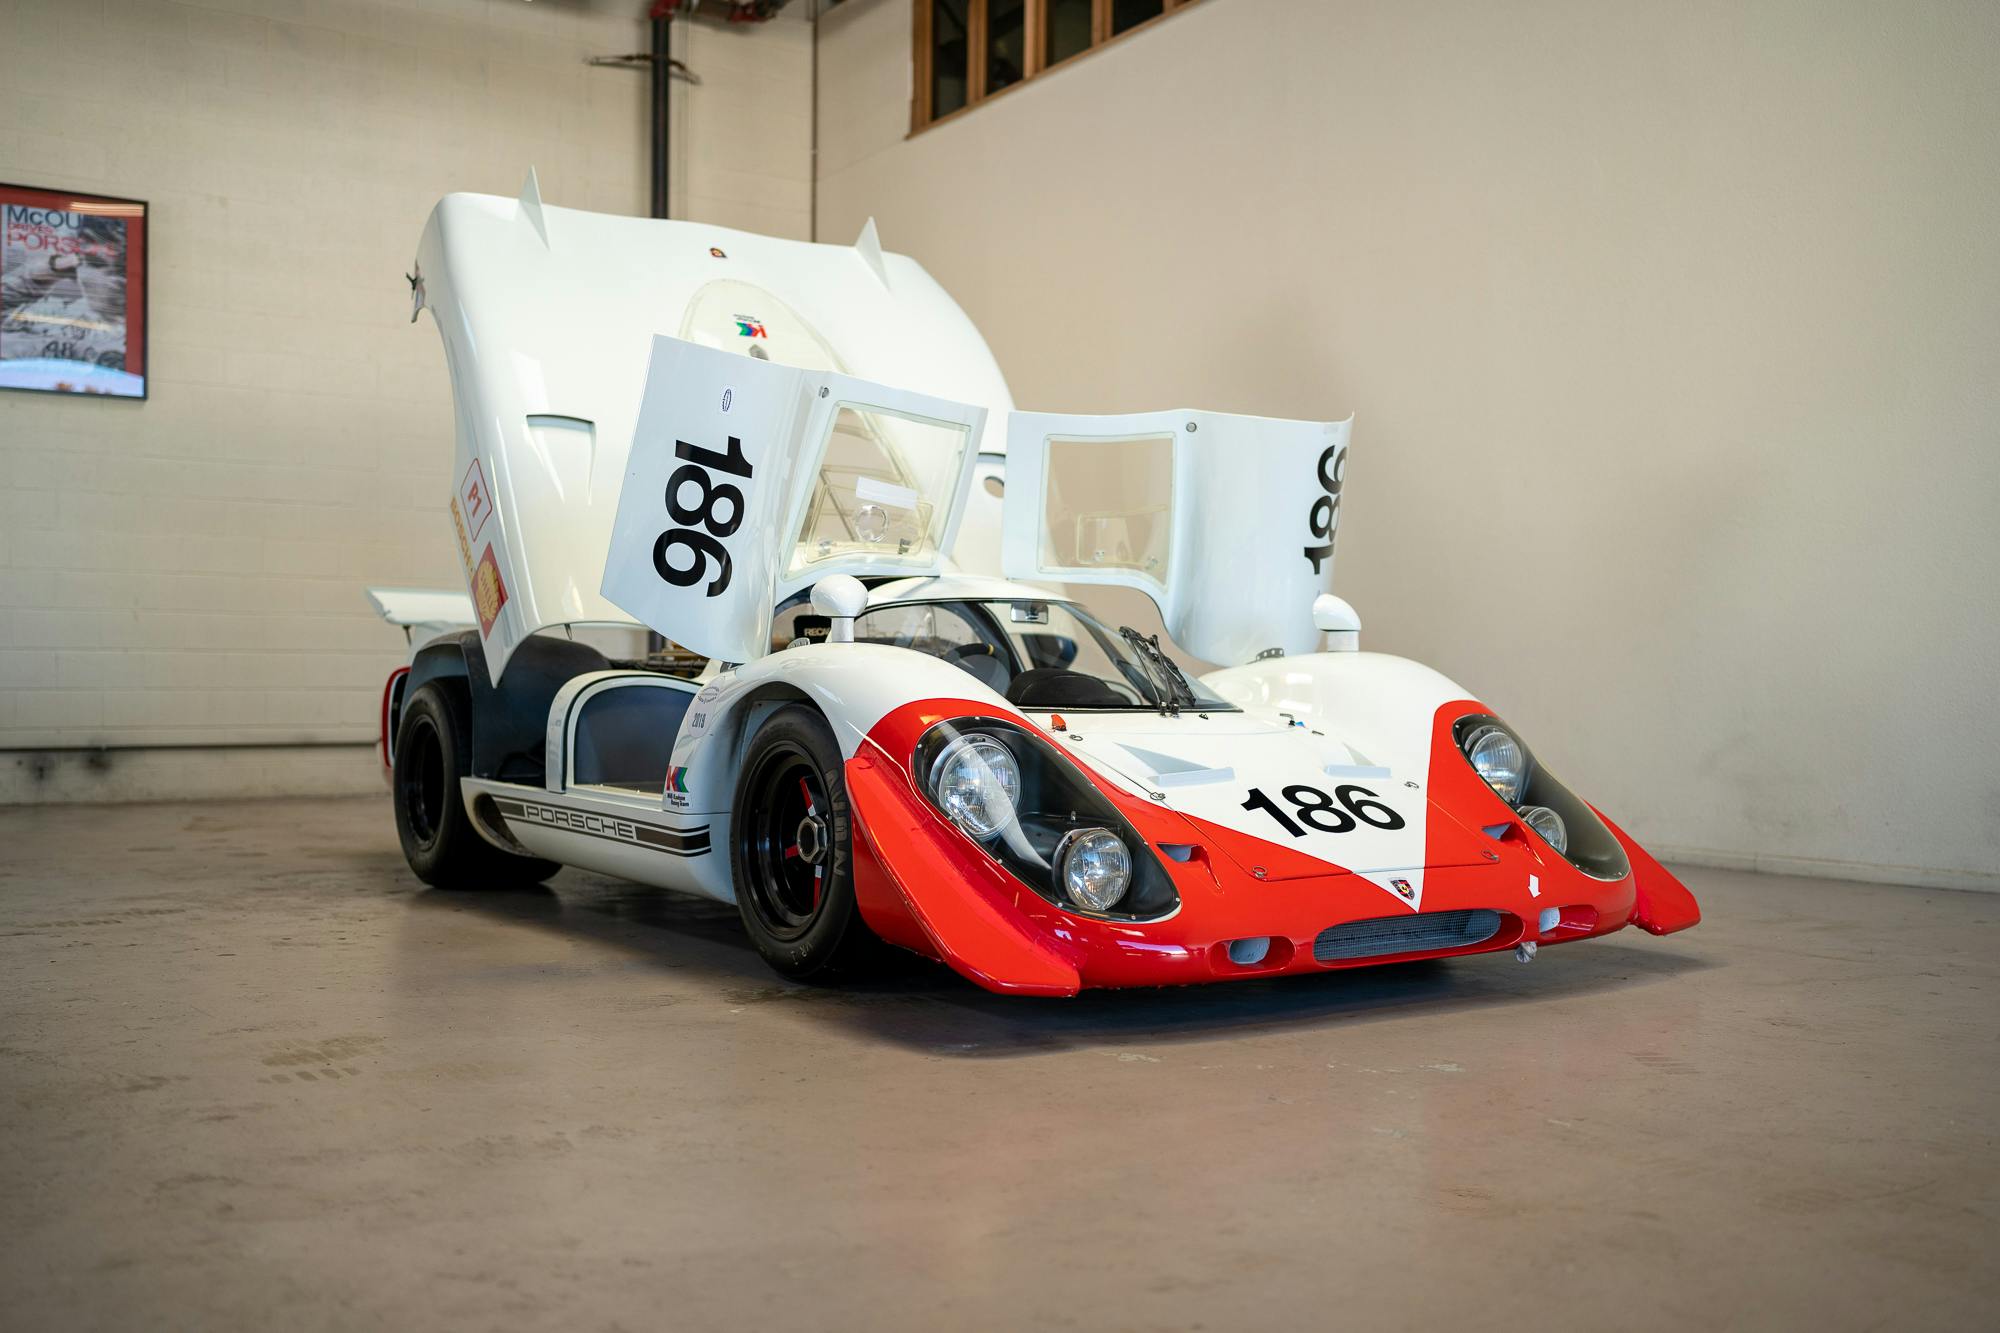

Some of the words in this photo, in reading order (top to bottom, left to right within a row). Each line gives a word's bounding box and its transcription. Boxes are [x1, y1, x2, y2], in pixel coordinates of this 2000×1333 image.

[652, 435, 754, 598] 186
[1303, 445, 1347, 575] 186
[525, 804, 635, 840] PORSCHE
[1240, 784, 1406, 838] 186
